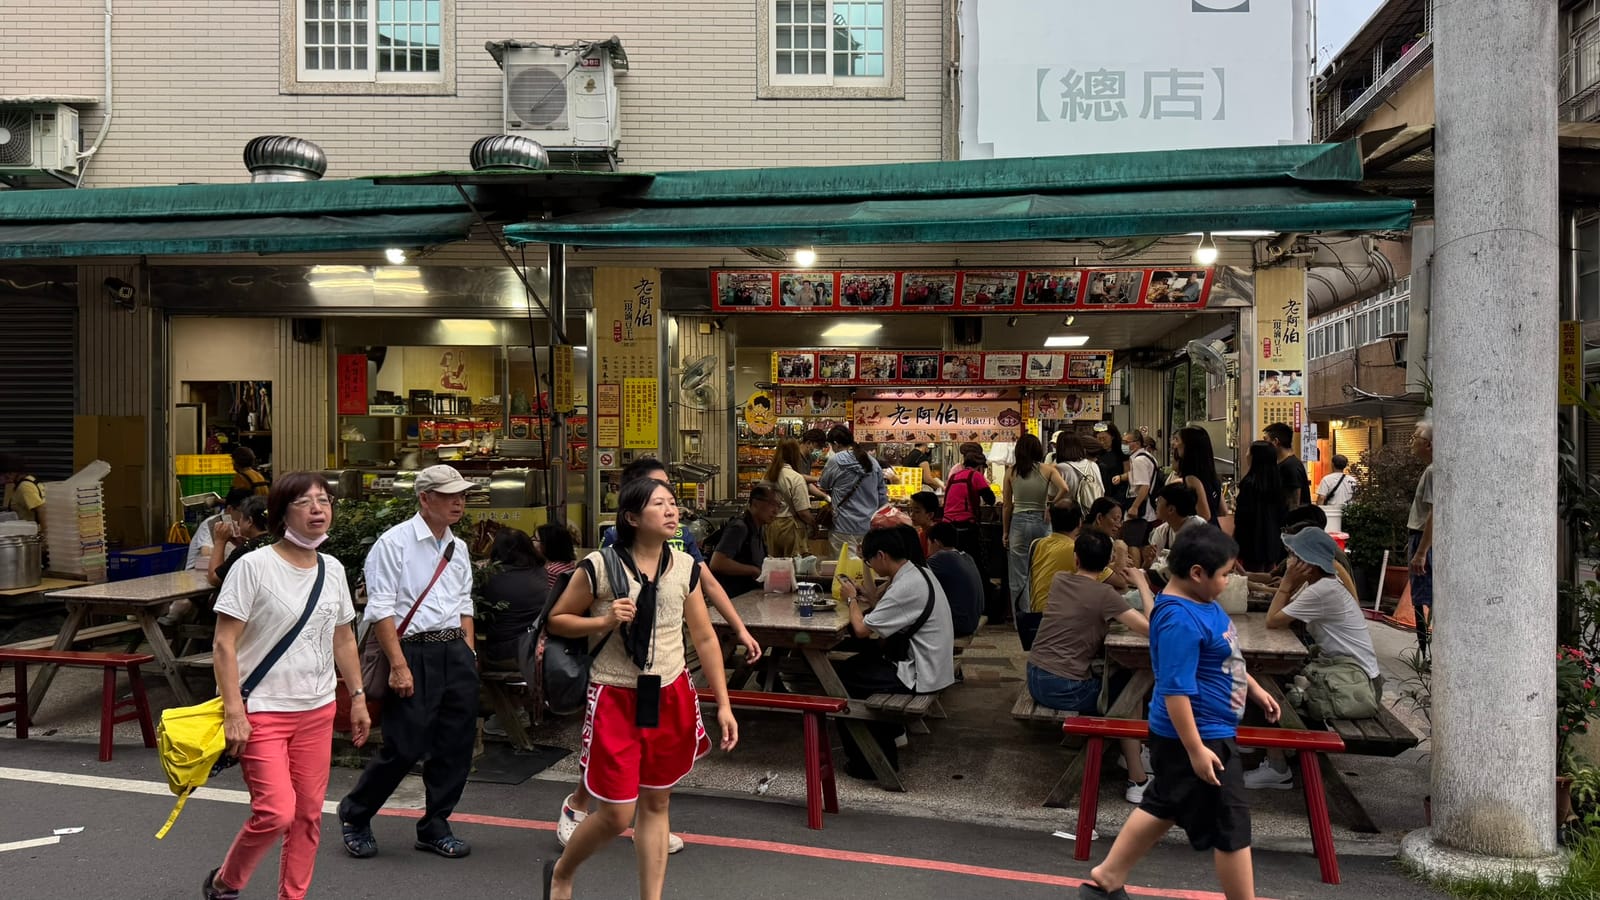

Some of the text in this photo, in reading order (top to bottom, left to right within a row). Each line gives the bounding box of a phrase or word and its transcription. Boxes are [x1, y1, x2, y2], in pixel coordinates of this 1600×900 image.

[1036, 67, 1226, 122] 【總店】
[634, 277, 655, 327] 老阿伯
[1282, 299, 1301, 344] 老阿伯
[887, 402, 958, 427] 老阿伯
